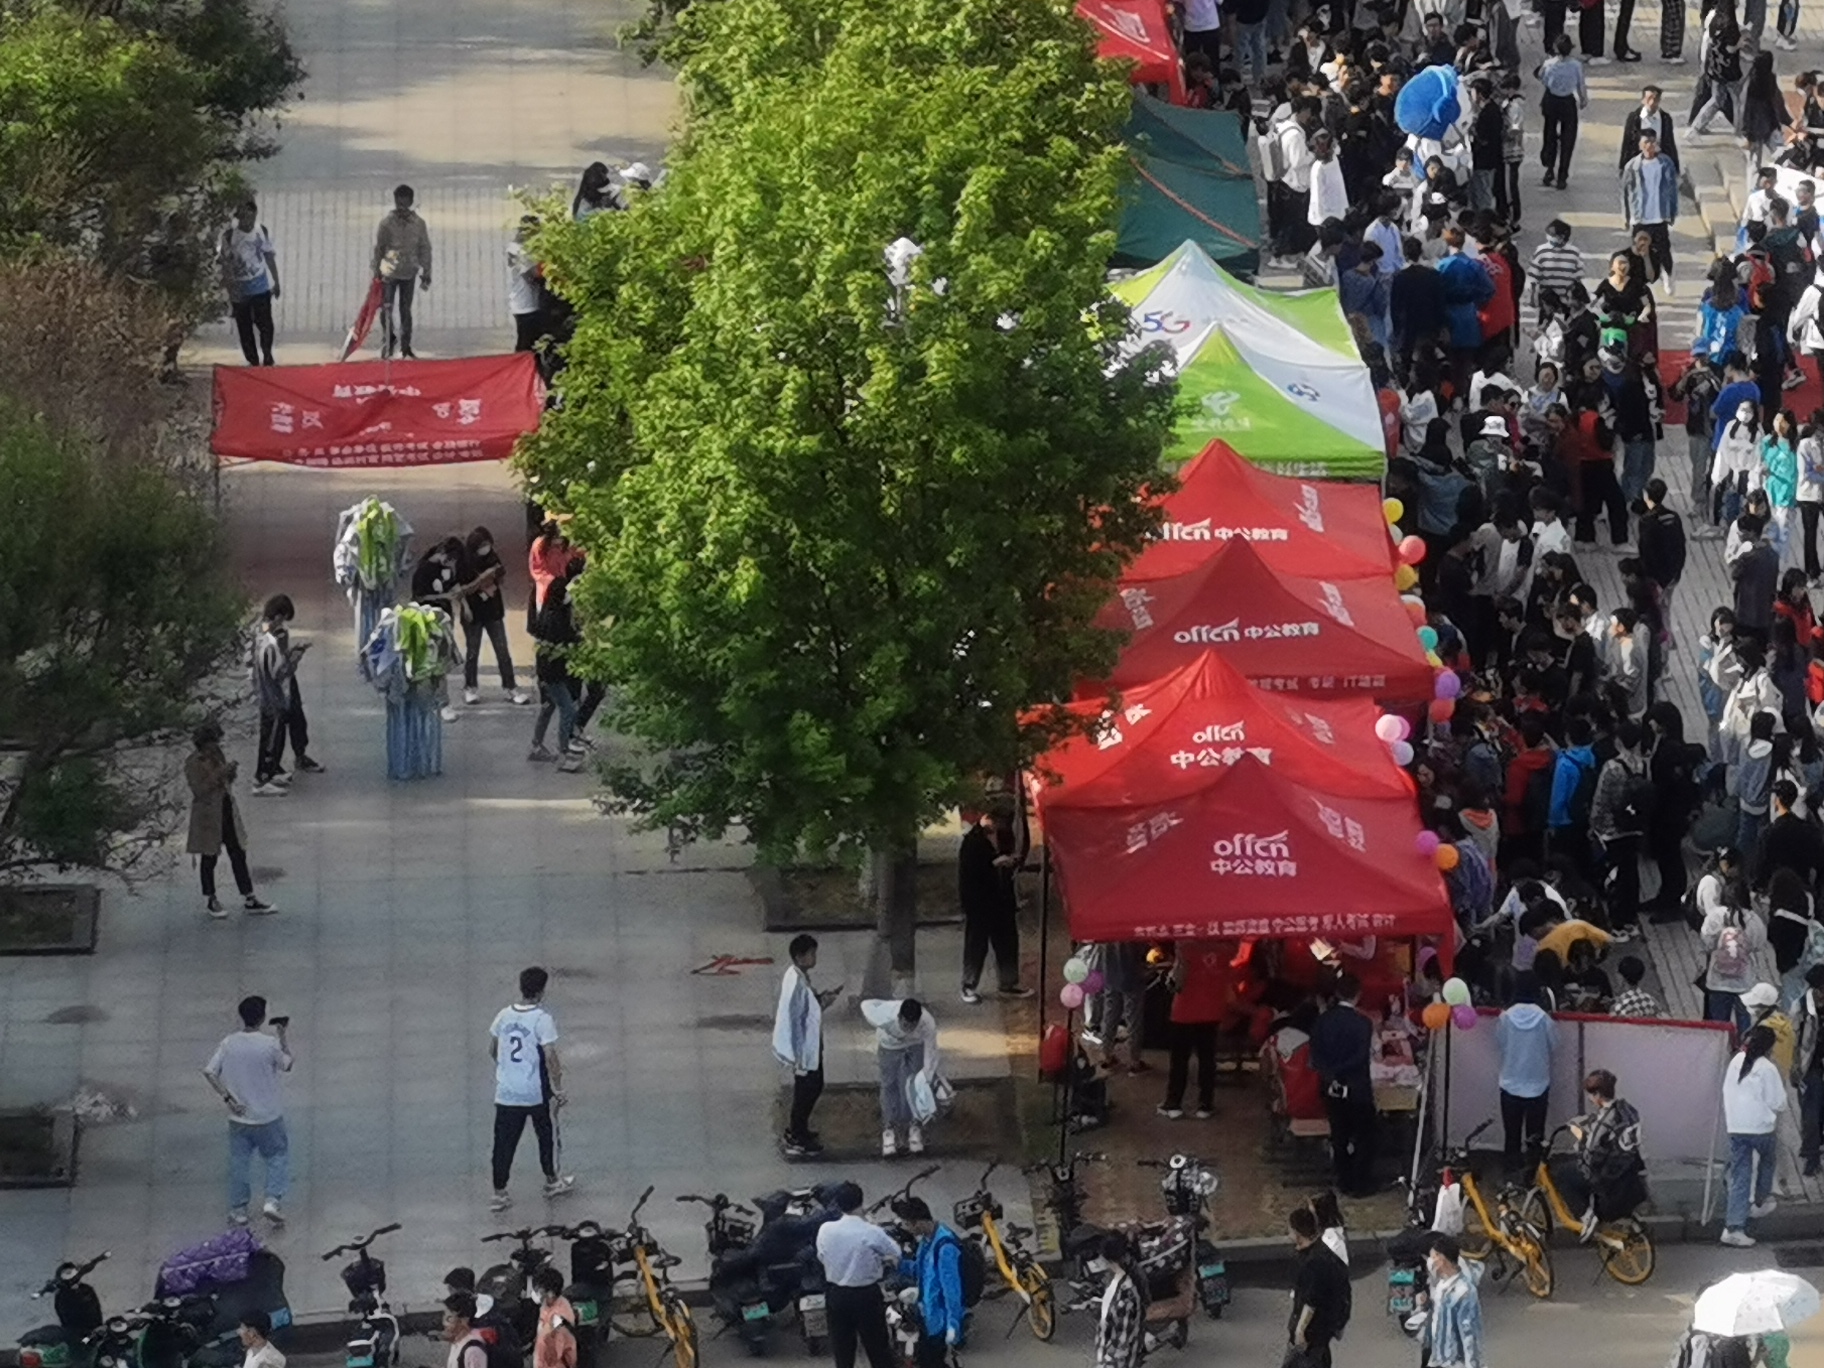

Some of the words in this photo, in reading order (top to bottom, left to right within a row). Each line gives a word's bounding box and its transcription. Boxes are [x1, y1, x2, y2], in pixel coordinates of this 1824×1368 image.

[1142, 311, 1191, 333] 5G
[1174, 617, 1240, 643] offcn
[1244, 621, 1320, 639] 中公教育
[1192, 721, 1244, 743] offcn
[1213, 830, 1290, 858] offcn
[1210, 859, 1297, 878] 中公教育
[509, 1036, 524, 1063] 2
